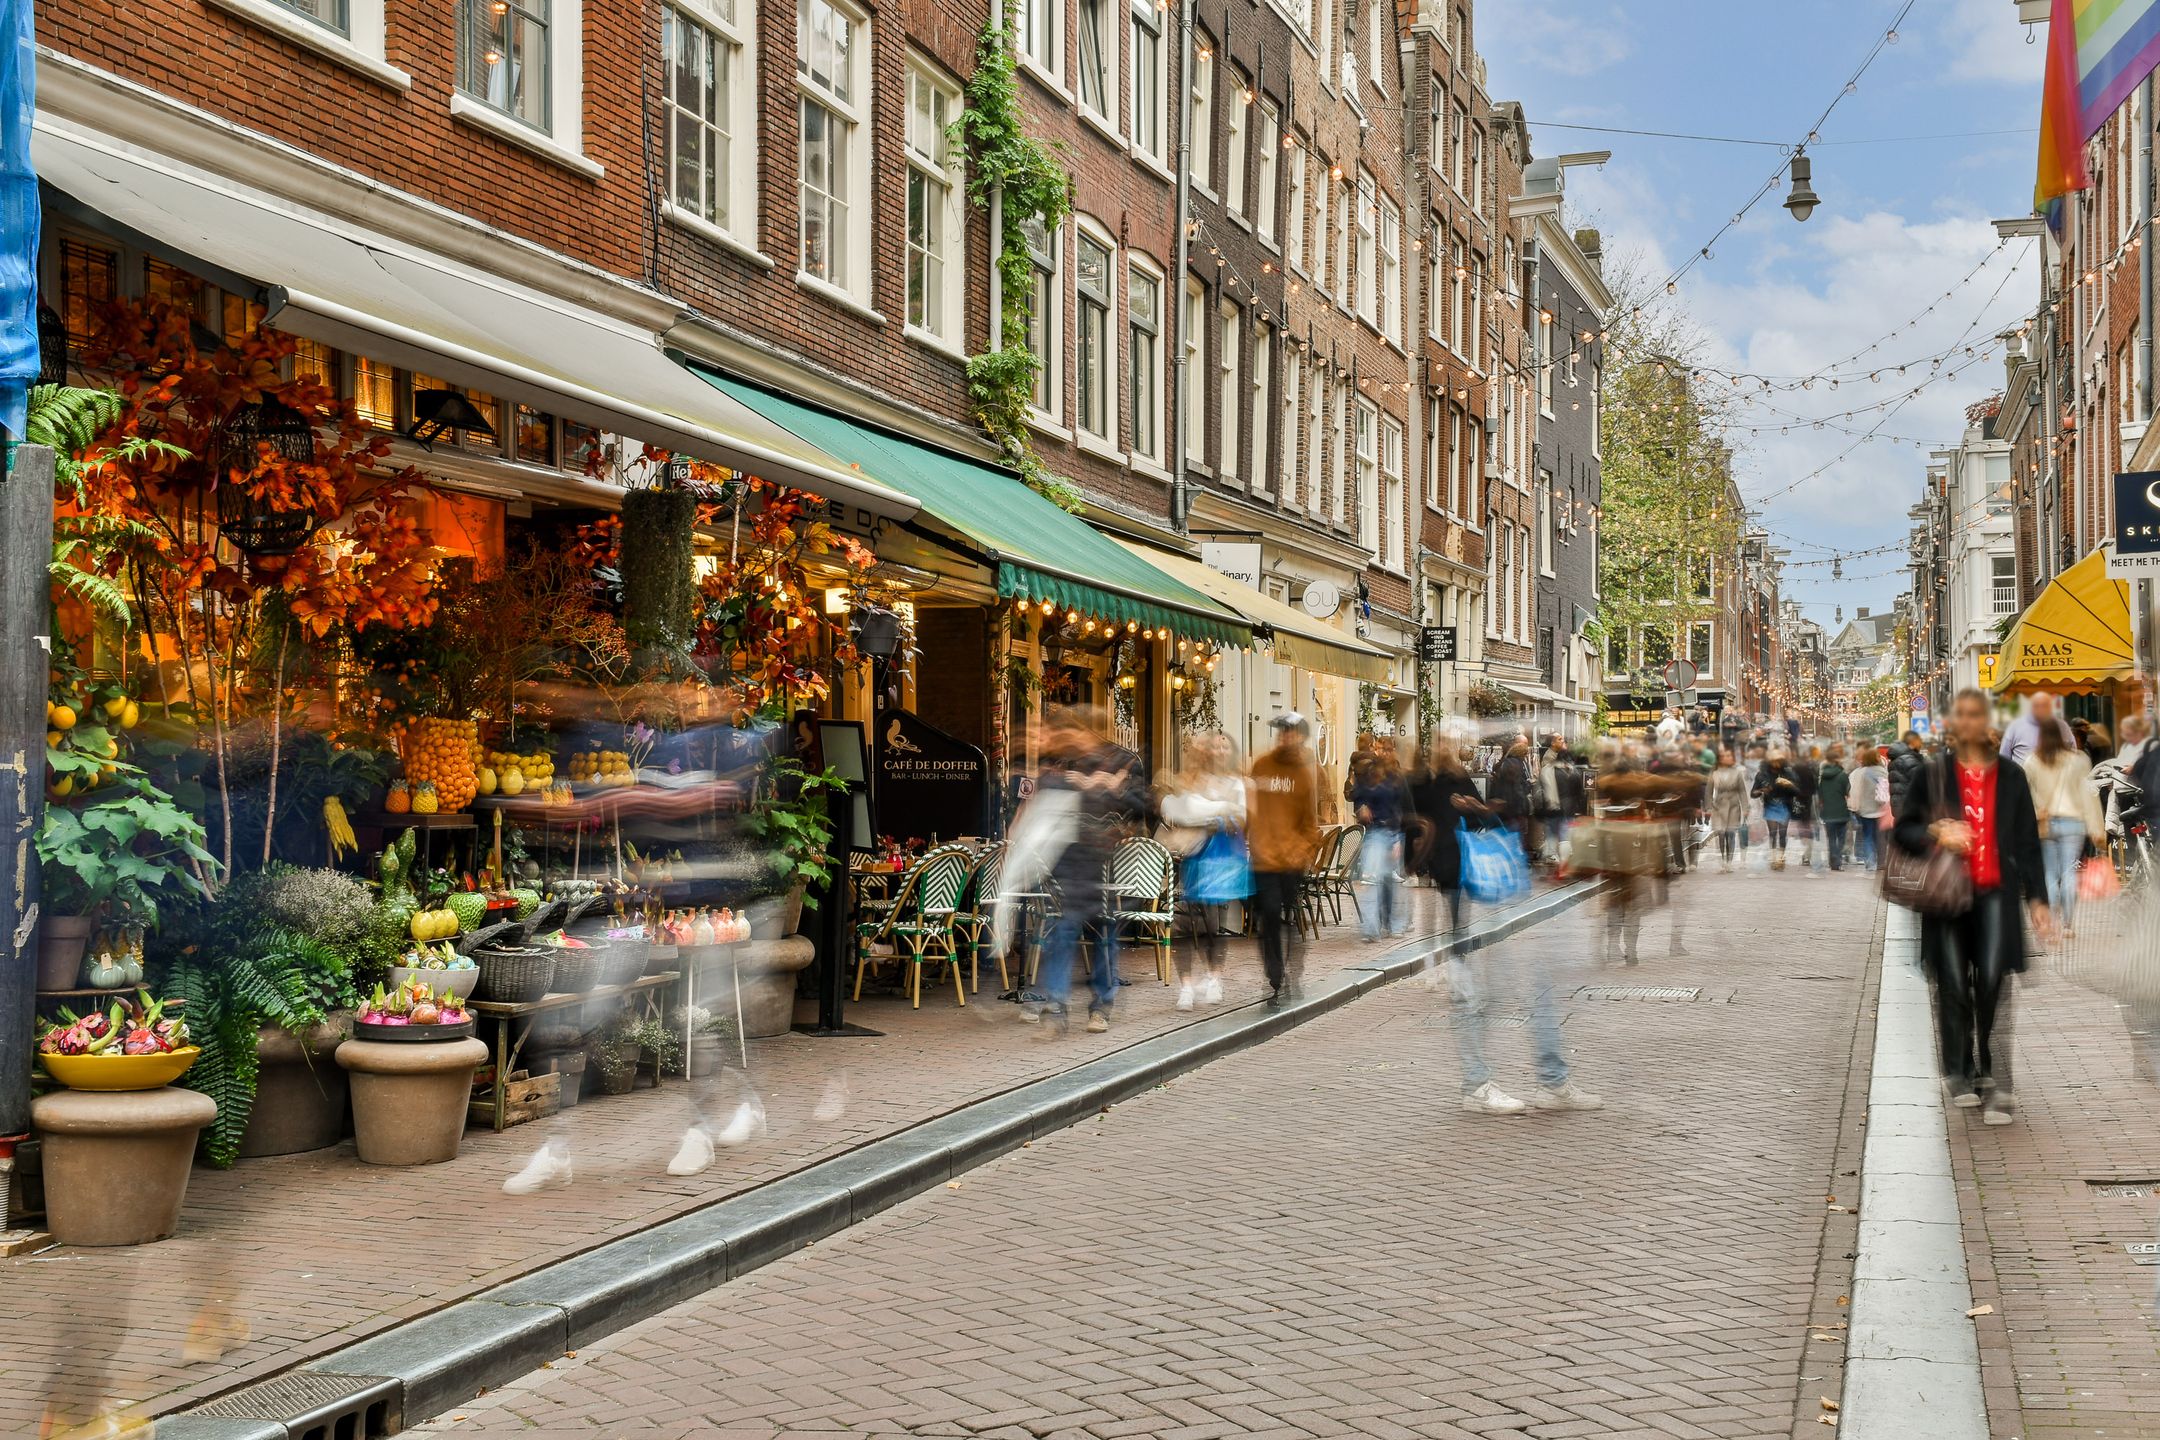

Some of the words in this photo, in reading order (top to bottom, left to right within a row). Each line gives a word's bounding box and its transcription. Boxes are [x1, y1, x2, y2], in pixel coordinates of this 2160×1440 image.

[2111, 558, 2133, 567] MEET
[2136, 557, 2147, 566] ME
[2022, 643, 2073, 657] KAAS
[2021, 657, 2074, 668] CHEESE
[1399, 724, 1406, 737] 6
[884, 758, 912, 770] CAFÉ
[915, 760, 930, 770] DE
[933, 760, 978, 771] DOFFER
[891, 772, 906, 780] BAR
[912, 772, 940, 780] LUNCH
[945, 773, 970, 781] DINER
